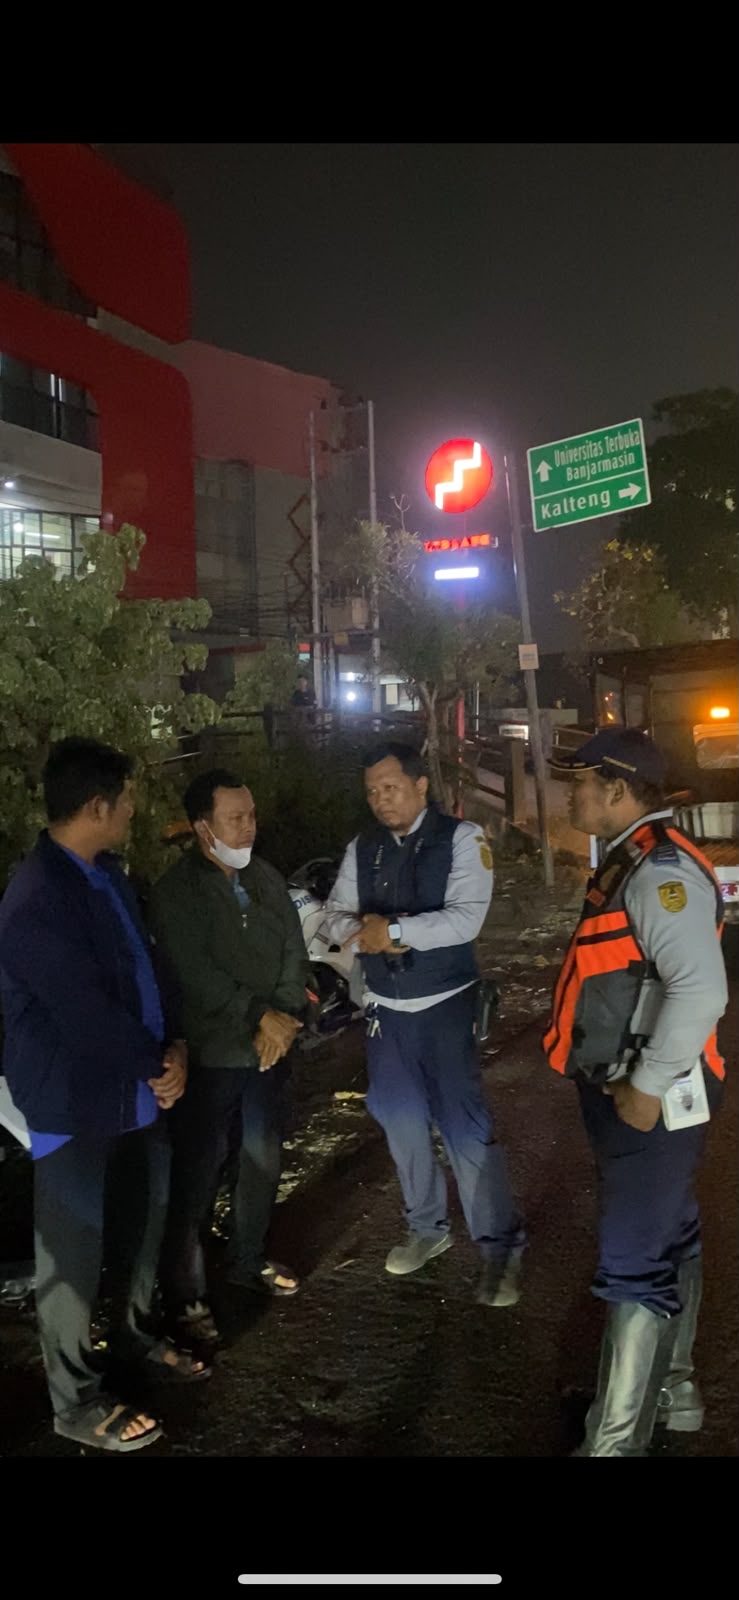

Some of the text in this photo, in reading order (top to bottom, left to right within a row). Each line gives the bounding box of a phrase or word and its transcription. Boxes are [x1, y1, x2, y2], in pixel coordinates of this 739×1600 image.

[554, 428, 640, 467] Universitas Terbuka
[566, 451, 635, 481] Banjarmasin
[541, 490, 610, 519] Kalteng
